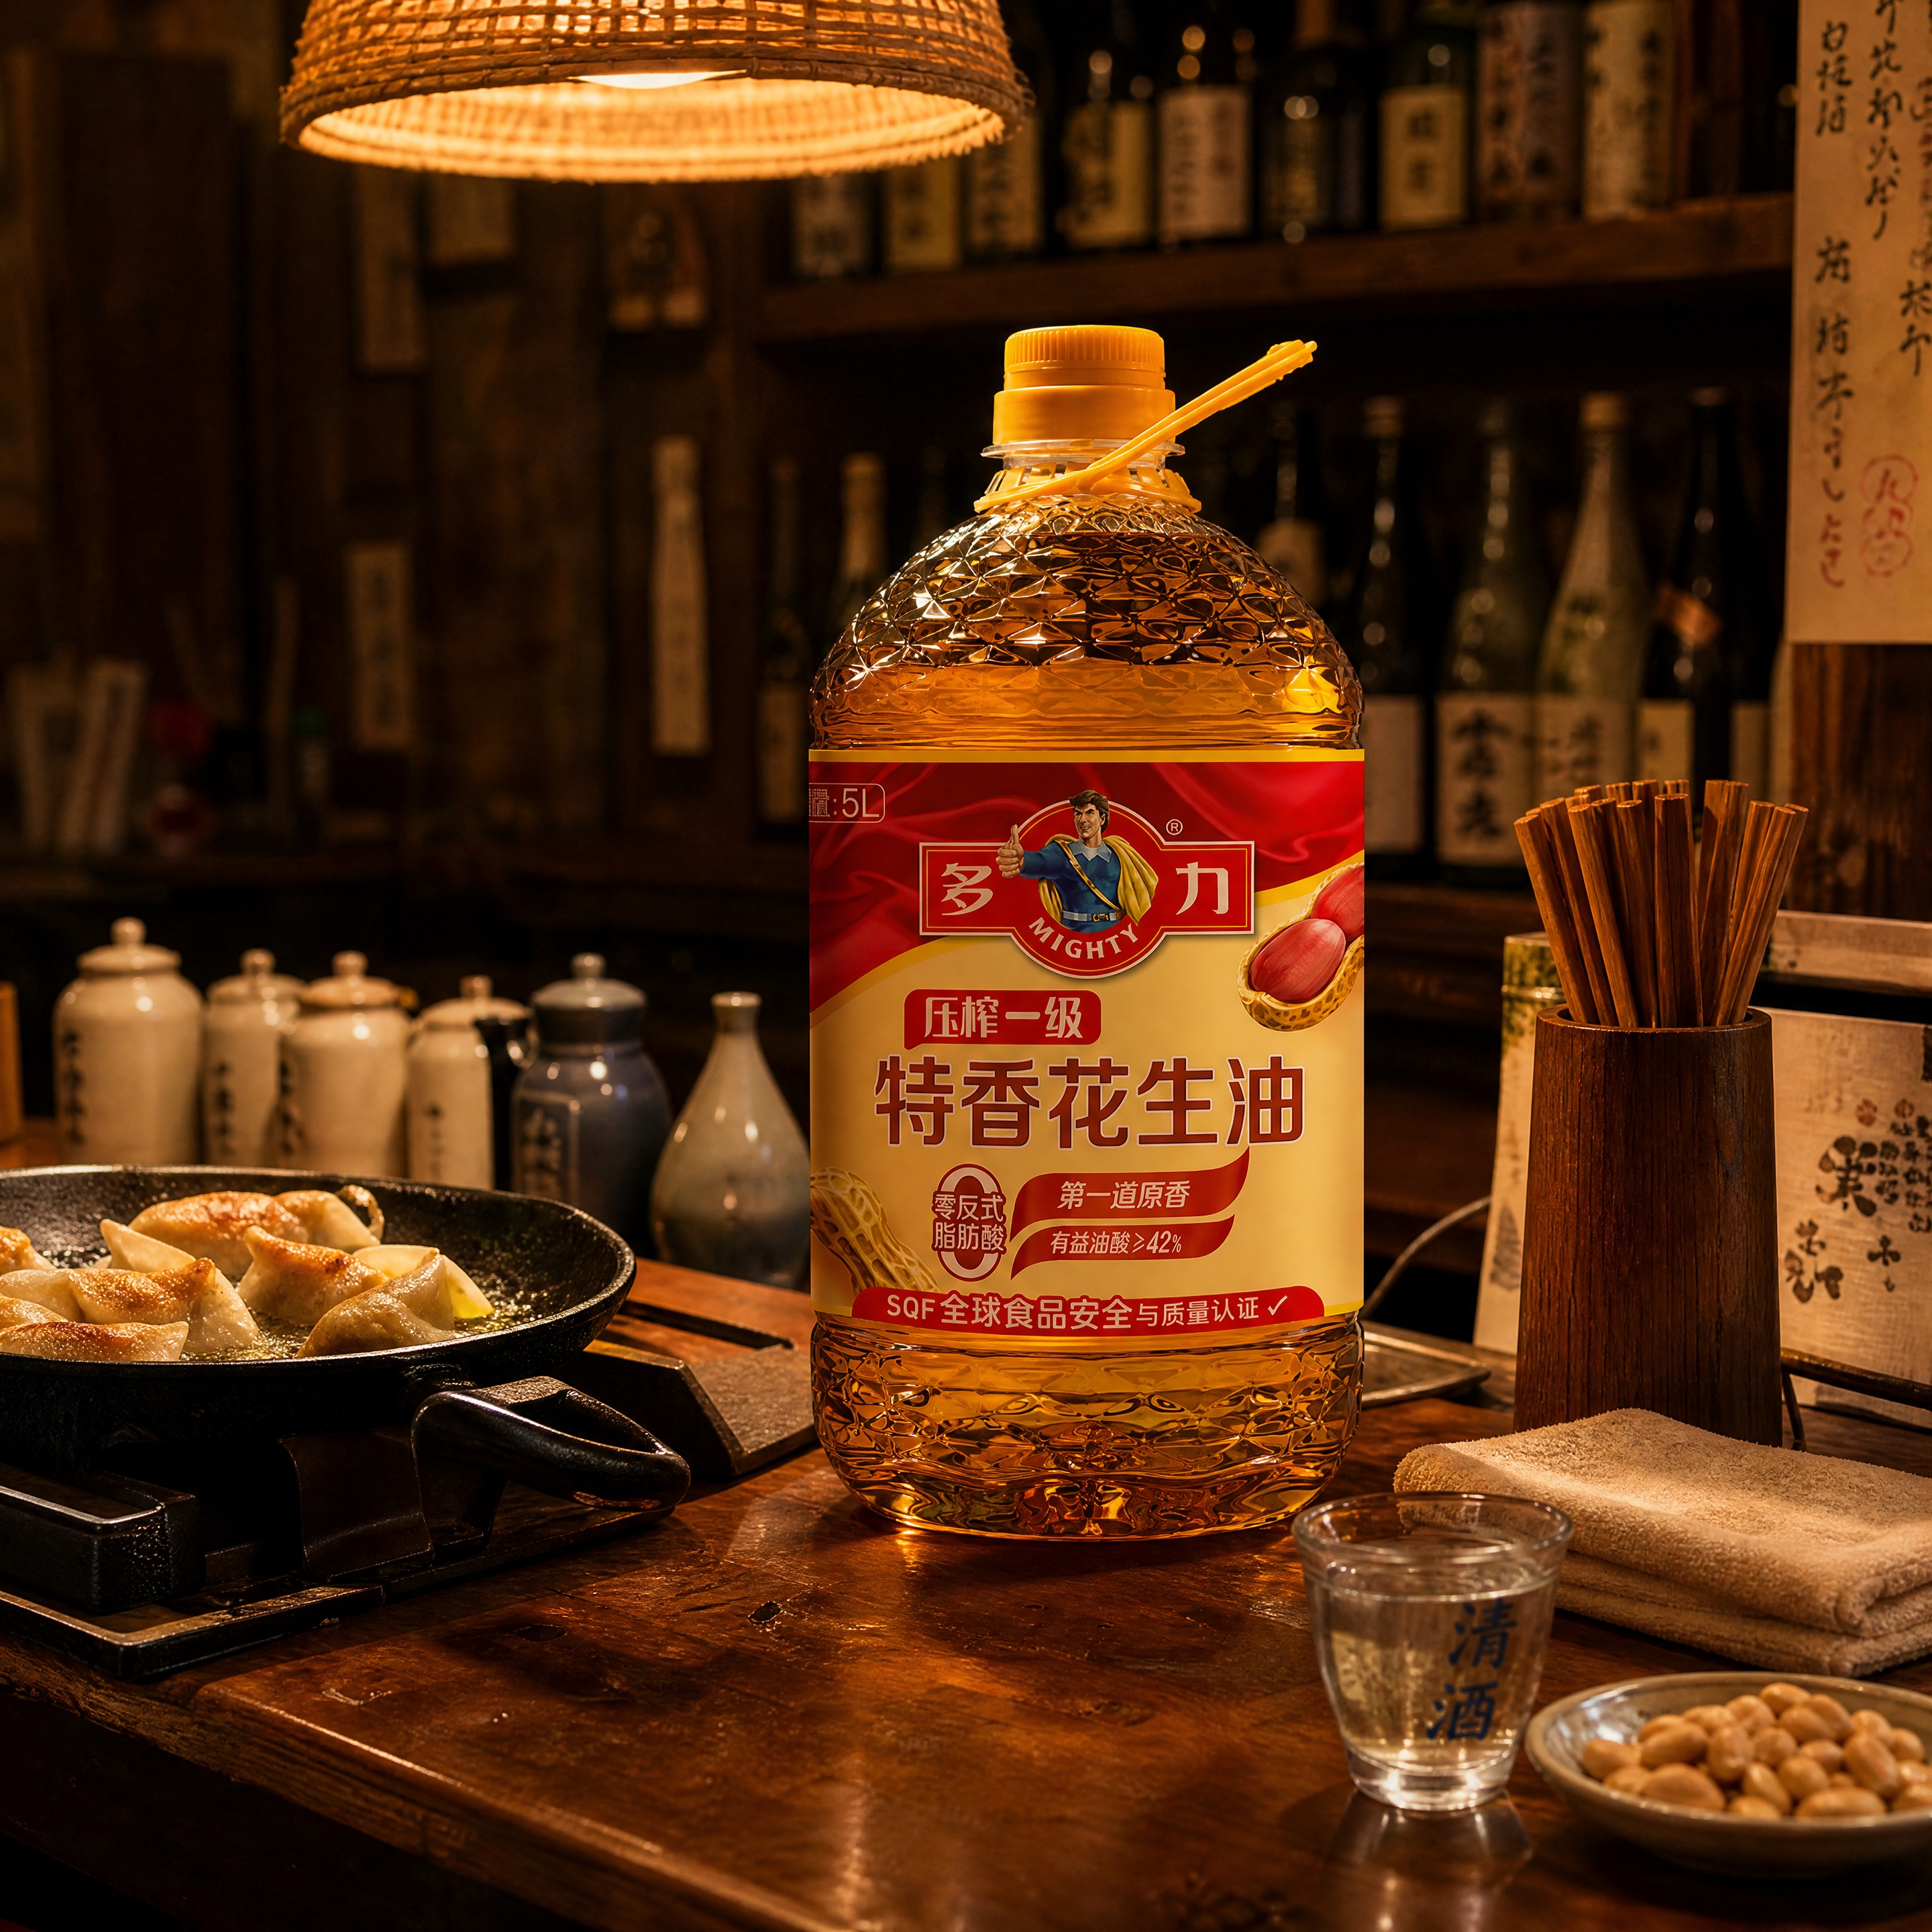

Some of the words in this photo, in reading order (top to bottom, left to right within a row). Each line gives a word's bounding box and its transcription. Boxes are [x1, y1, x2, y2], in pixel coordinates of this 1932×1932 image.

[1028, 917, 1138, 959] MIGHTY
[924, 996, 1083, 1038] 压榨一级
[874, 1055, 1305, 1150] 特香花生油
[934, 1193, 1004, 1222] 零反式
[1057, 1180, 1191, 1210] 第一道原香
[934, 1222, 1004, 1252] 脂肪酸
[1426, 1597, 1517, 1741] 清酒
